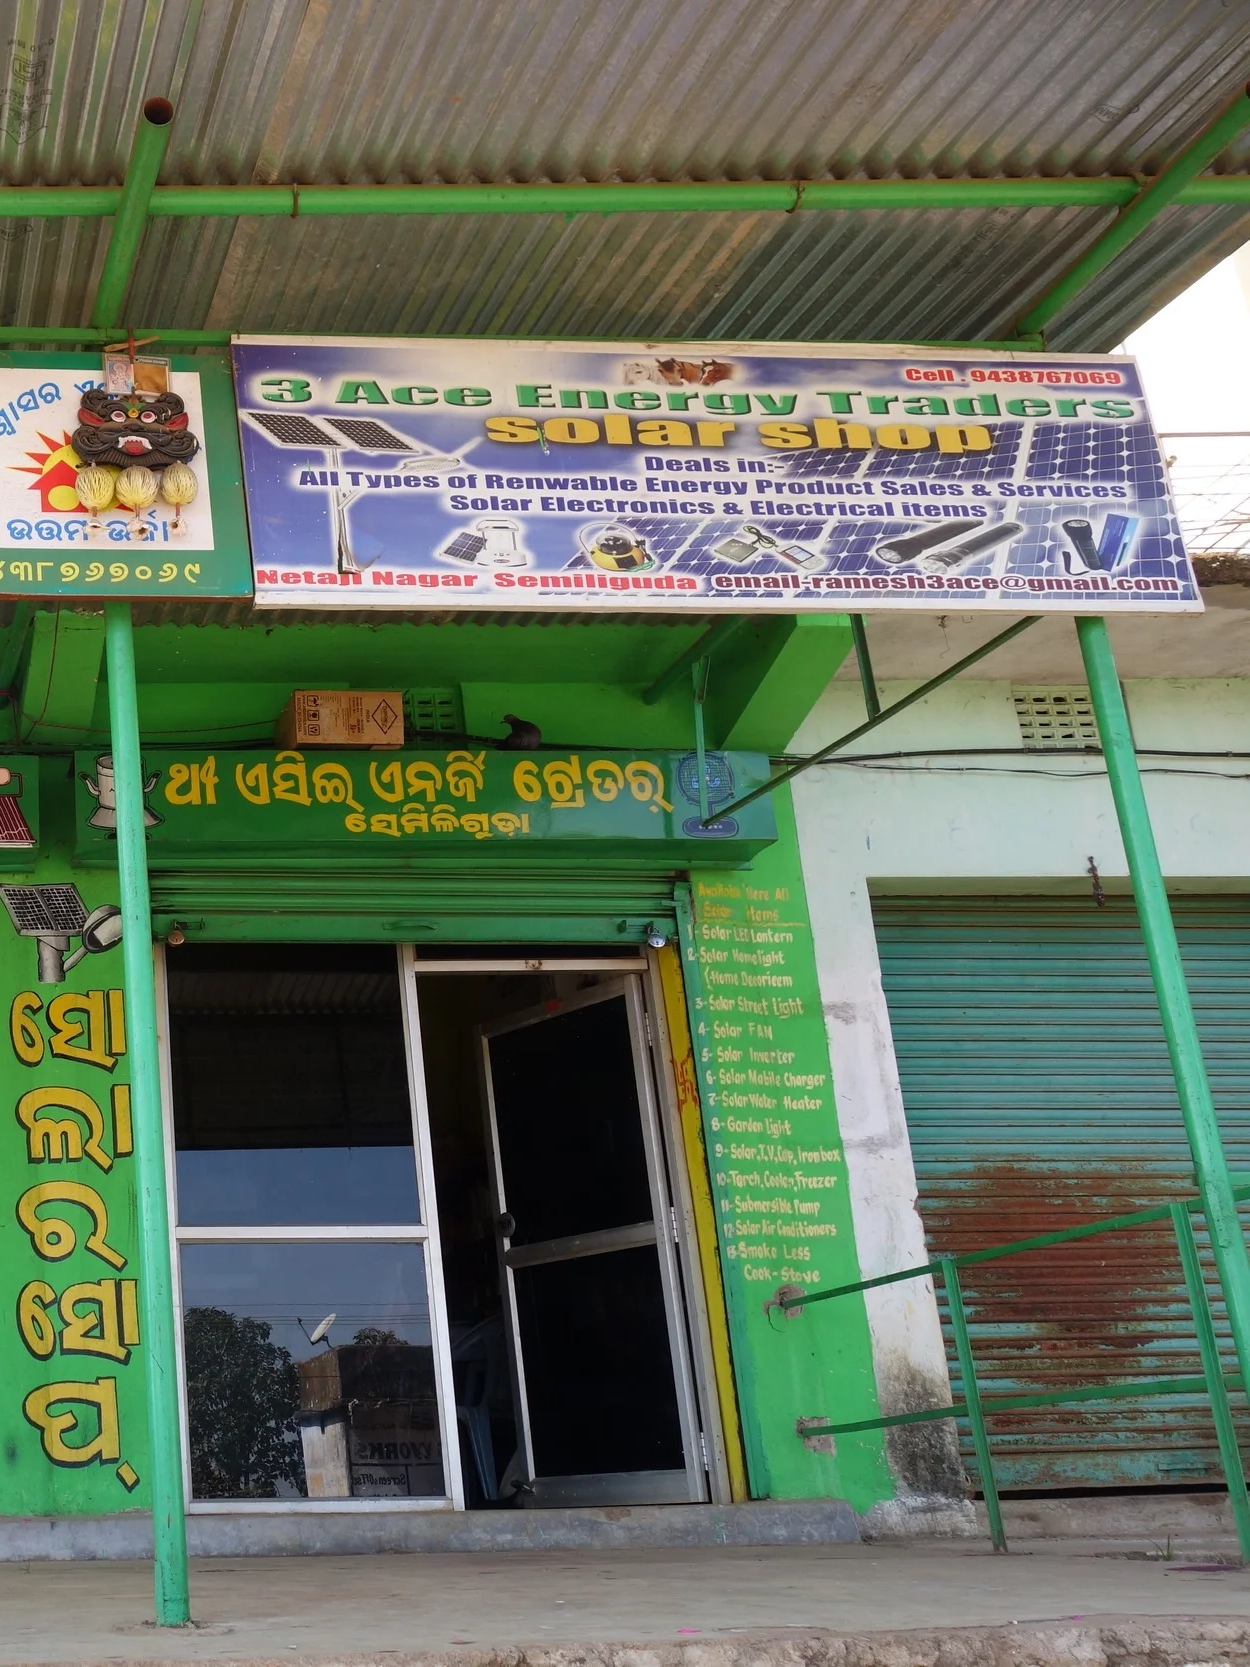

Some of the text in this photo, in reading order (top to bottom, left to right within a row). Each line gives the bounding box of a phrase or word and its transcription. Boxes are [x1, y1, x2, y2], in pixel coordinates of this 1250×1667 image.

[905, 368, 1121, 385] Cell 9438767069
[260, 379, 1135, 419] 3 Ace Energy Traders
[485, 414, 992, 454] solar shop
[645, 456, 739, 473] Deals
[299, 470, 1127, 499] All Types of Renwable Energy Product Sales & Services
[450, 495, 987, 517] Solar Electronics & Electrical items
[372, 569, 477, 588] Nagar
[494, 571, 697, 590] Semiliguda
[702, 924, 731, 940] Solar
[699, 946, 728, 963] Solar
[709, 995, 735, 1012] Solar
[713, 1021, 742, 1039] Solar
[717, 1047, 743, 1064] Solar
[719, 1068, 746, 1085] Solar
